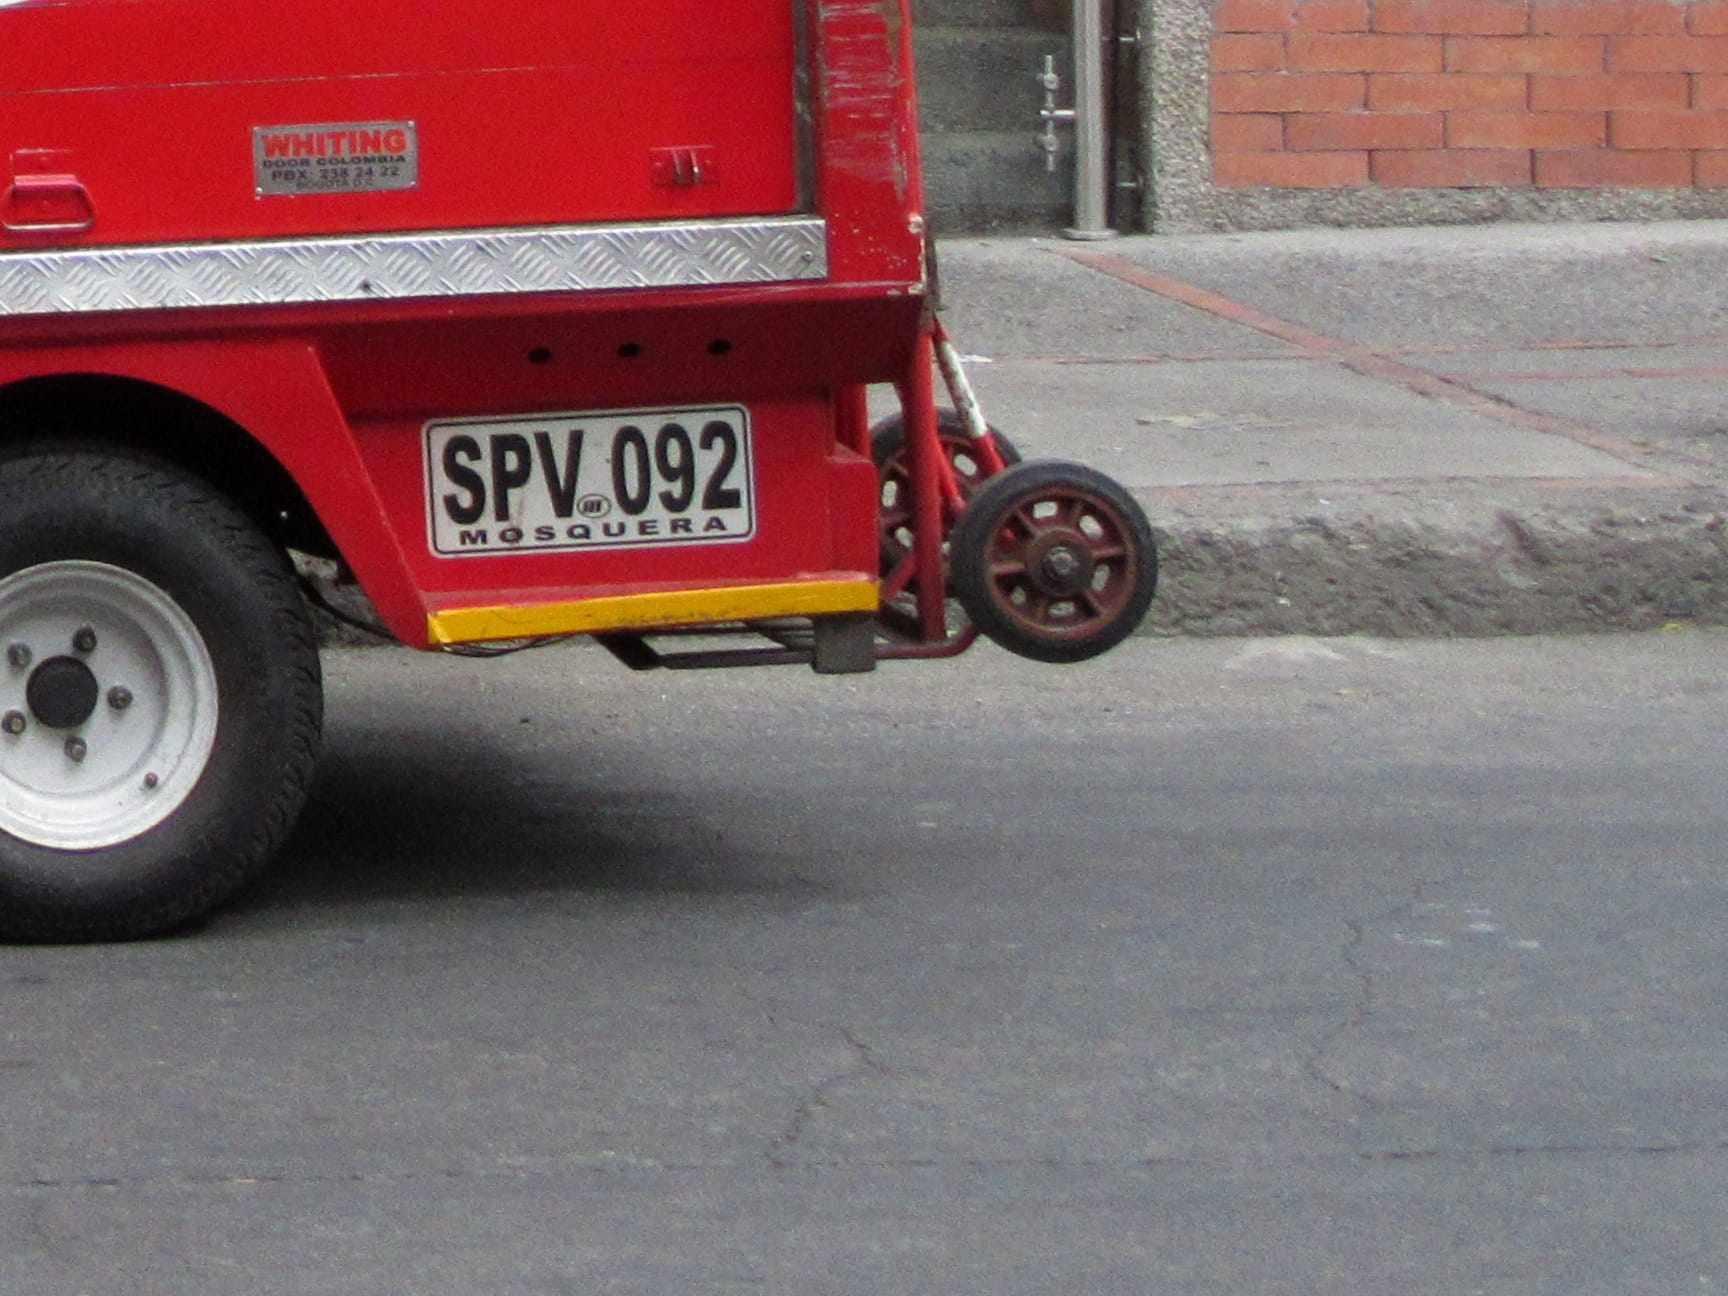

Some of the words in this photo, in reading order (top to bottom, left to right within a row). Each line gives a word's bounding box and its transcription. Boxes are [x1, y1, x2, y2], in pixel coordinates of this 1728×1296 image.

[261, 128, 408, 158] WHITING
[263, 159, 311, 169] DOOR
[316, 154, 407, 167] COLOMBIA
[380, 166, 401, 177] 22
[442, 429, 585, 525] SPV
[610, 420, 742, 516] 092
[458, 514, 729, 547] MOSQUERA
